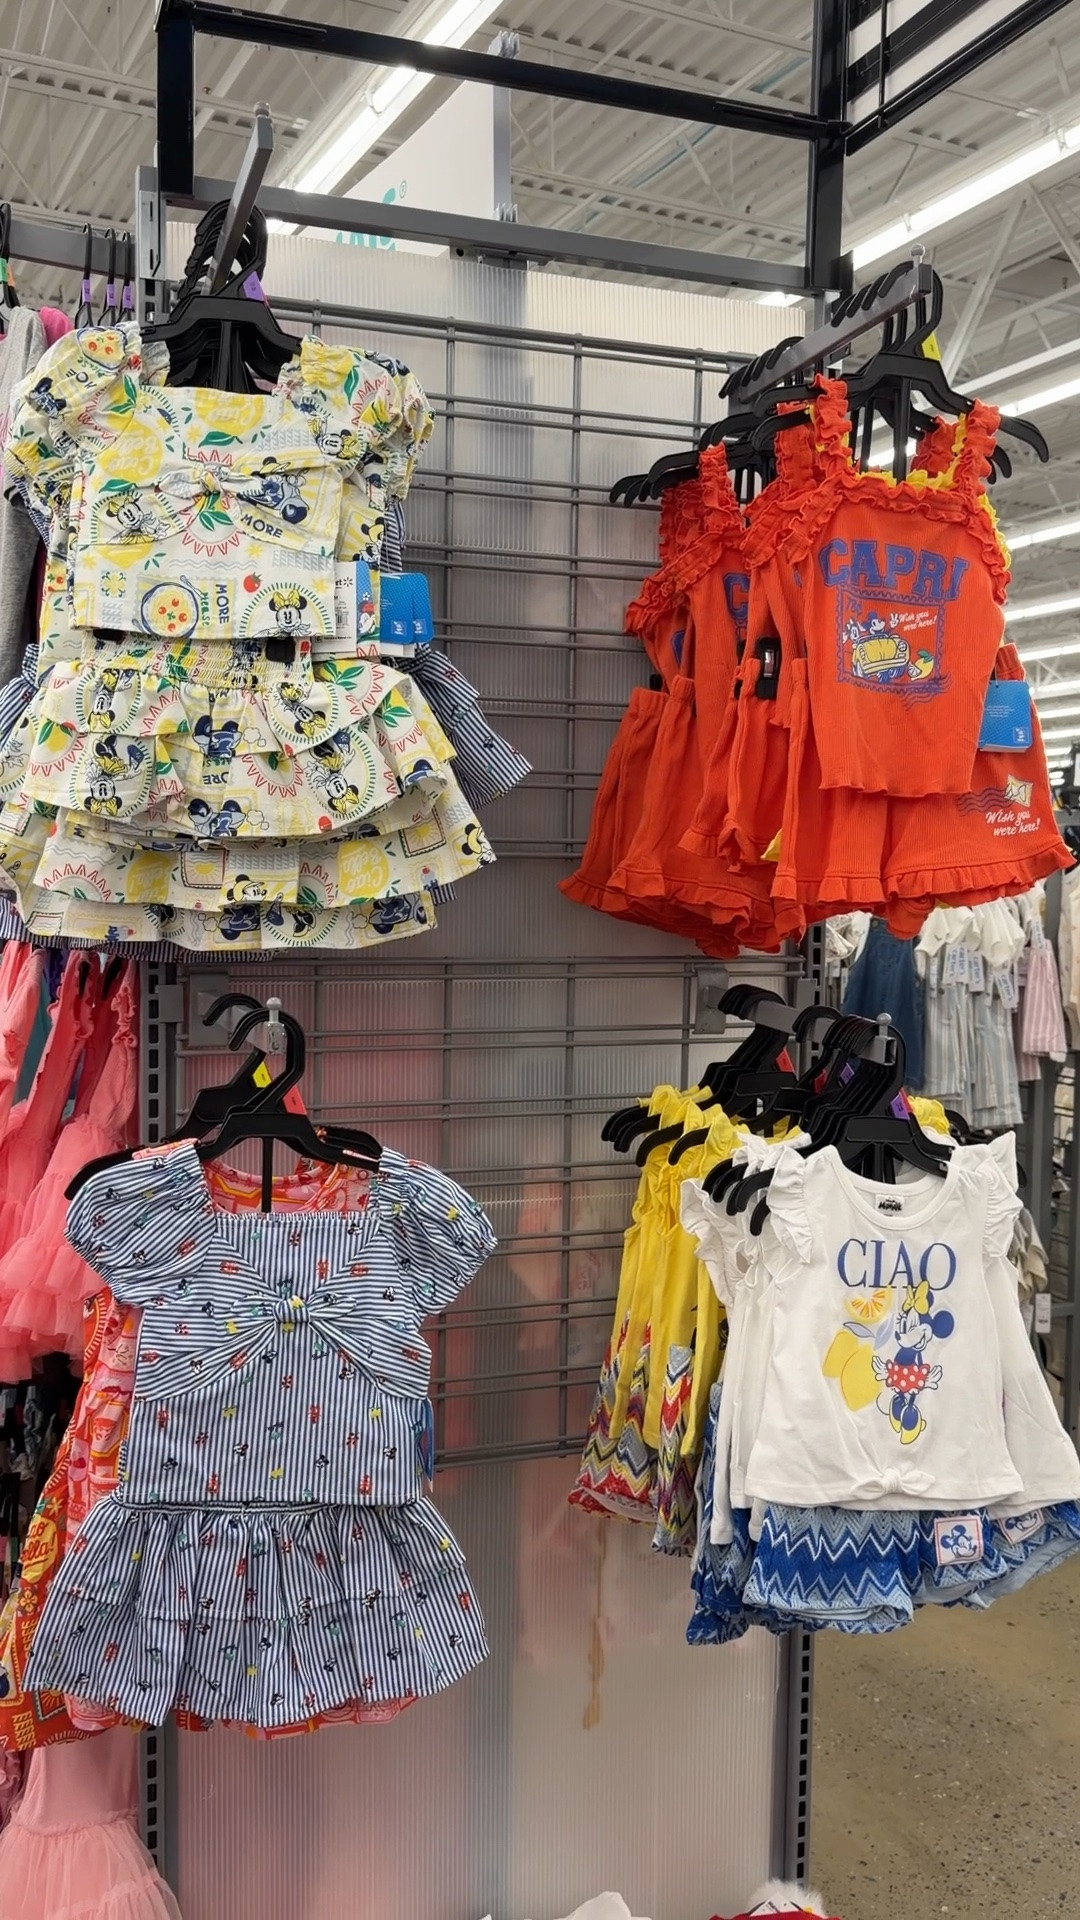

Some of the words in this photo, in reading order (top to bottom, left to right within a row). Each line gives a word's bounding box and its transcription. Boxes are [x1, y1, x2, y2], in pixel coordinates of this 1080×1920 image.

[65, 368, 97, 390] MOE
[240, 513, 283, 540] MORE
[818, 538, 969, 602] CAPRI
[215, 584, 230, 624] MORE
[202, 771, 229, 785] ORE
[986, 809, 1015, 823] Wish
[1015, 810, 1030, 827] you
[993, 826, 1017, 836] were
[1018, 818, 1041, 833] here!
[837, 1238, 957, 1291] CIAO
[29, 1521, 49, 1538] ao
[21, 1531, 56, 1562] ella!
